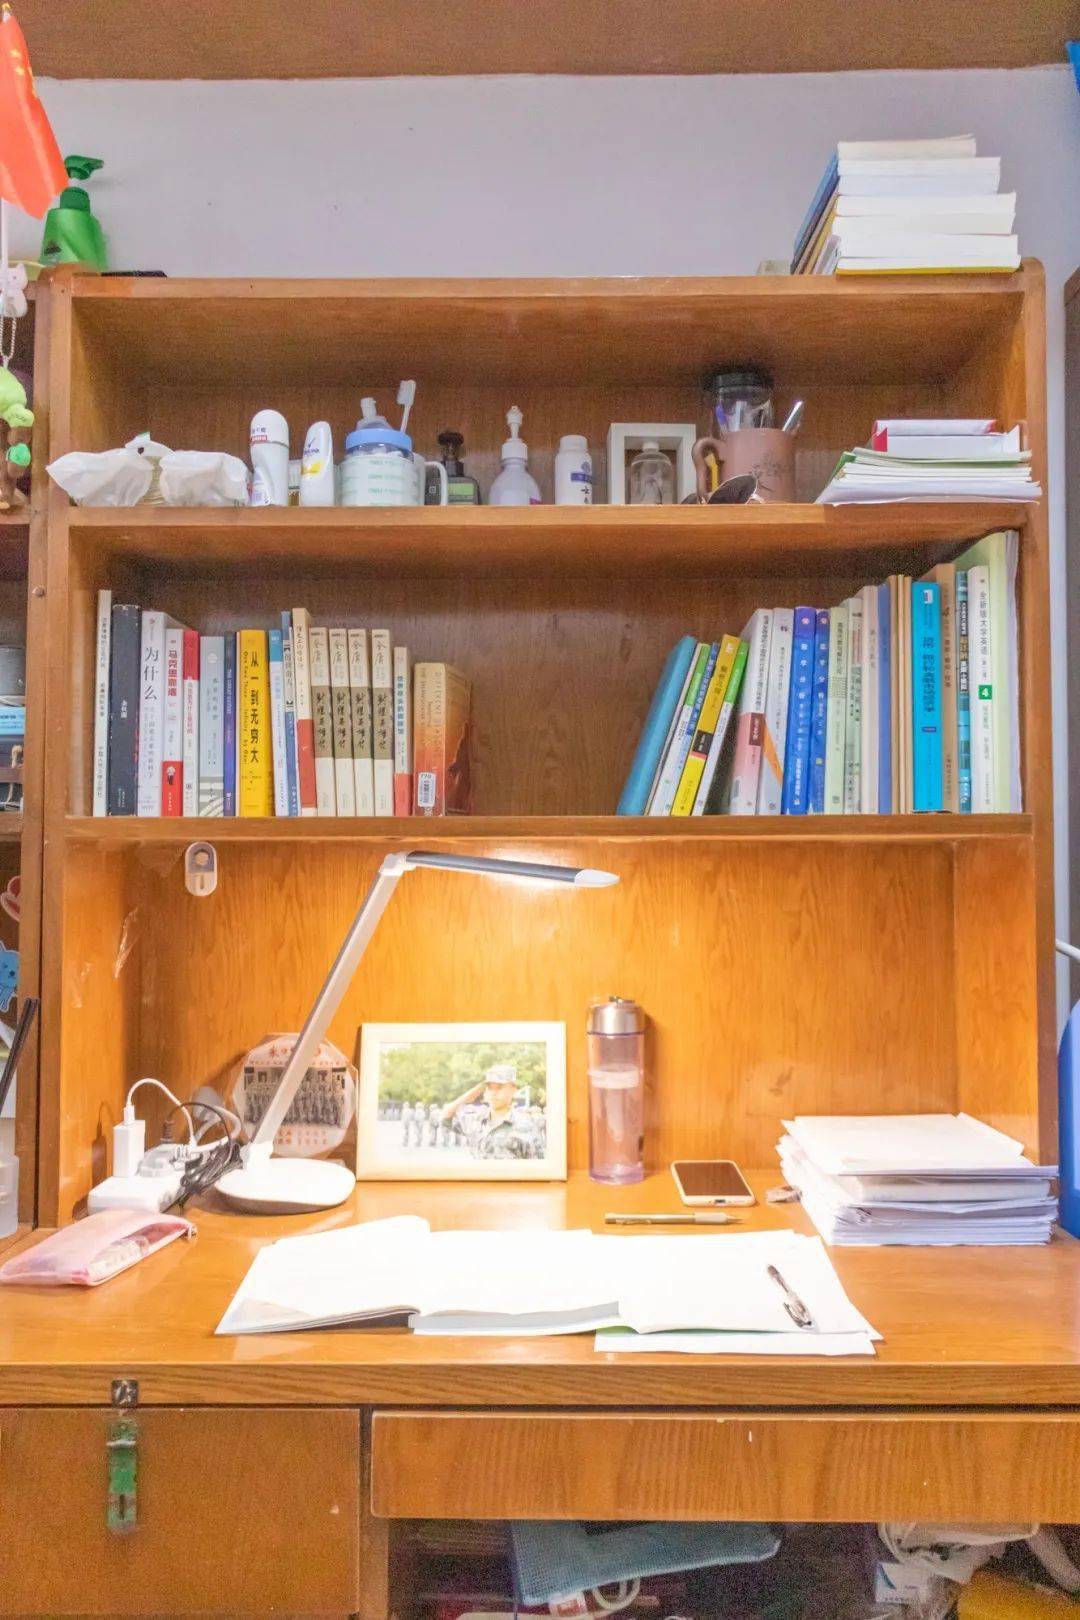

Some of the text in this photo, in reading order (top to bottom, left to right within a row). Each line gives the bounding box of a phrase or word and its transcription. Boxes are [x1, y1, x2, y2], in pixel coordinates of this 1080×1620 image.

[143, 646, 159, 700] 为什么
[981, 688, 989, 697] 4
[250, 652, 259, 763] 从一到无穷大
